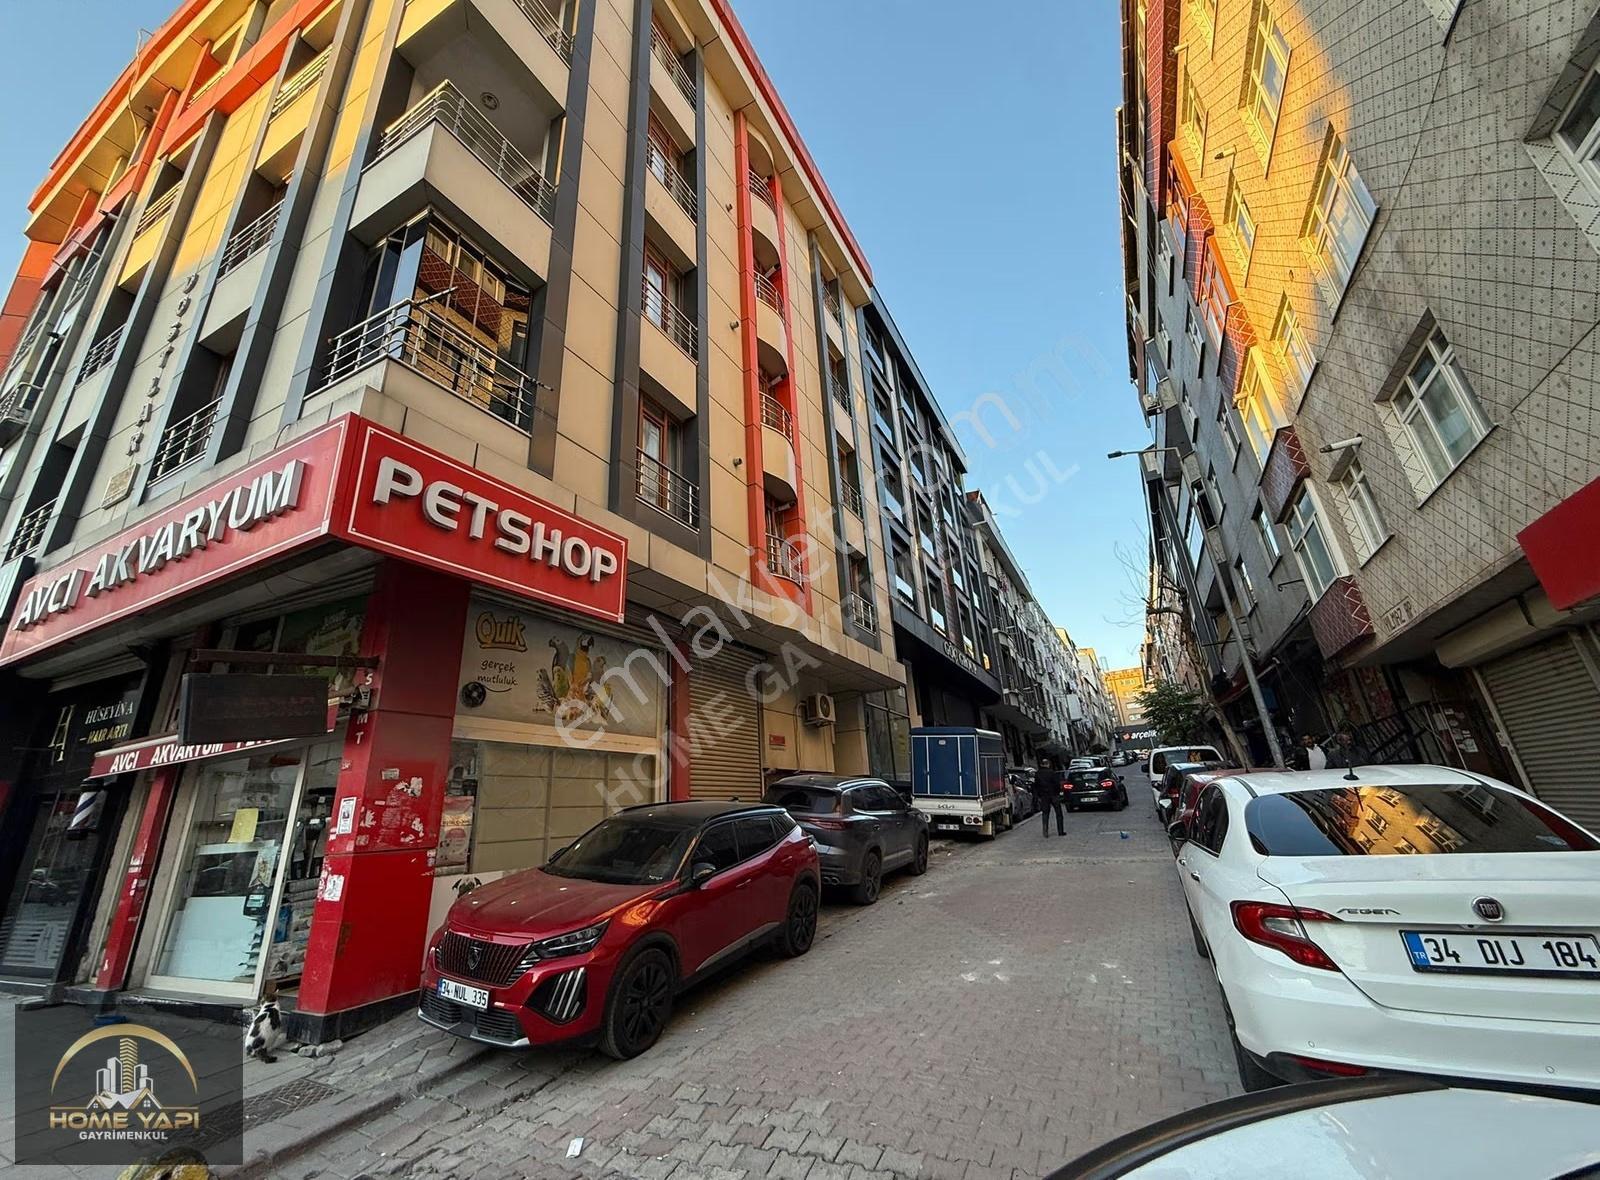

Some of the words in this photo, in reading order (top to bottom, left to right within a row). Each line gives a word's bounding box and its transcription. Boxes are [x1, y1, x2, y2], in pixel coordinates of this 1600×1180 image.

[373, 456, 618, 582] PETSHOP
[13, 568, 86, 631] AVCI
[85, 459, 305, 598] AKVARYUM
[476, 612, 527, 652] Quik
[481, 660, 515, 673] gerçek
[1130, 729, 1158, 740] arçelik
[109, 750, 140, 773] AVCI
[1479, 902, 1500, 918] FIAT
[1413, 951, 1428, 961] TR
[1424, 938, 1461, 964] 34
[1476, 938, 1525, 966] DIJ
[1542, 940, 1598, 969] 184
[471, 989, 487, 1007] 335
